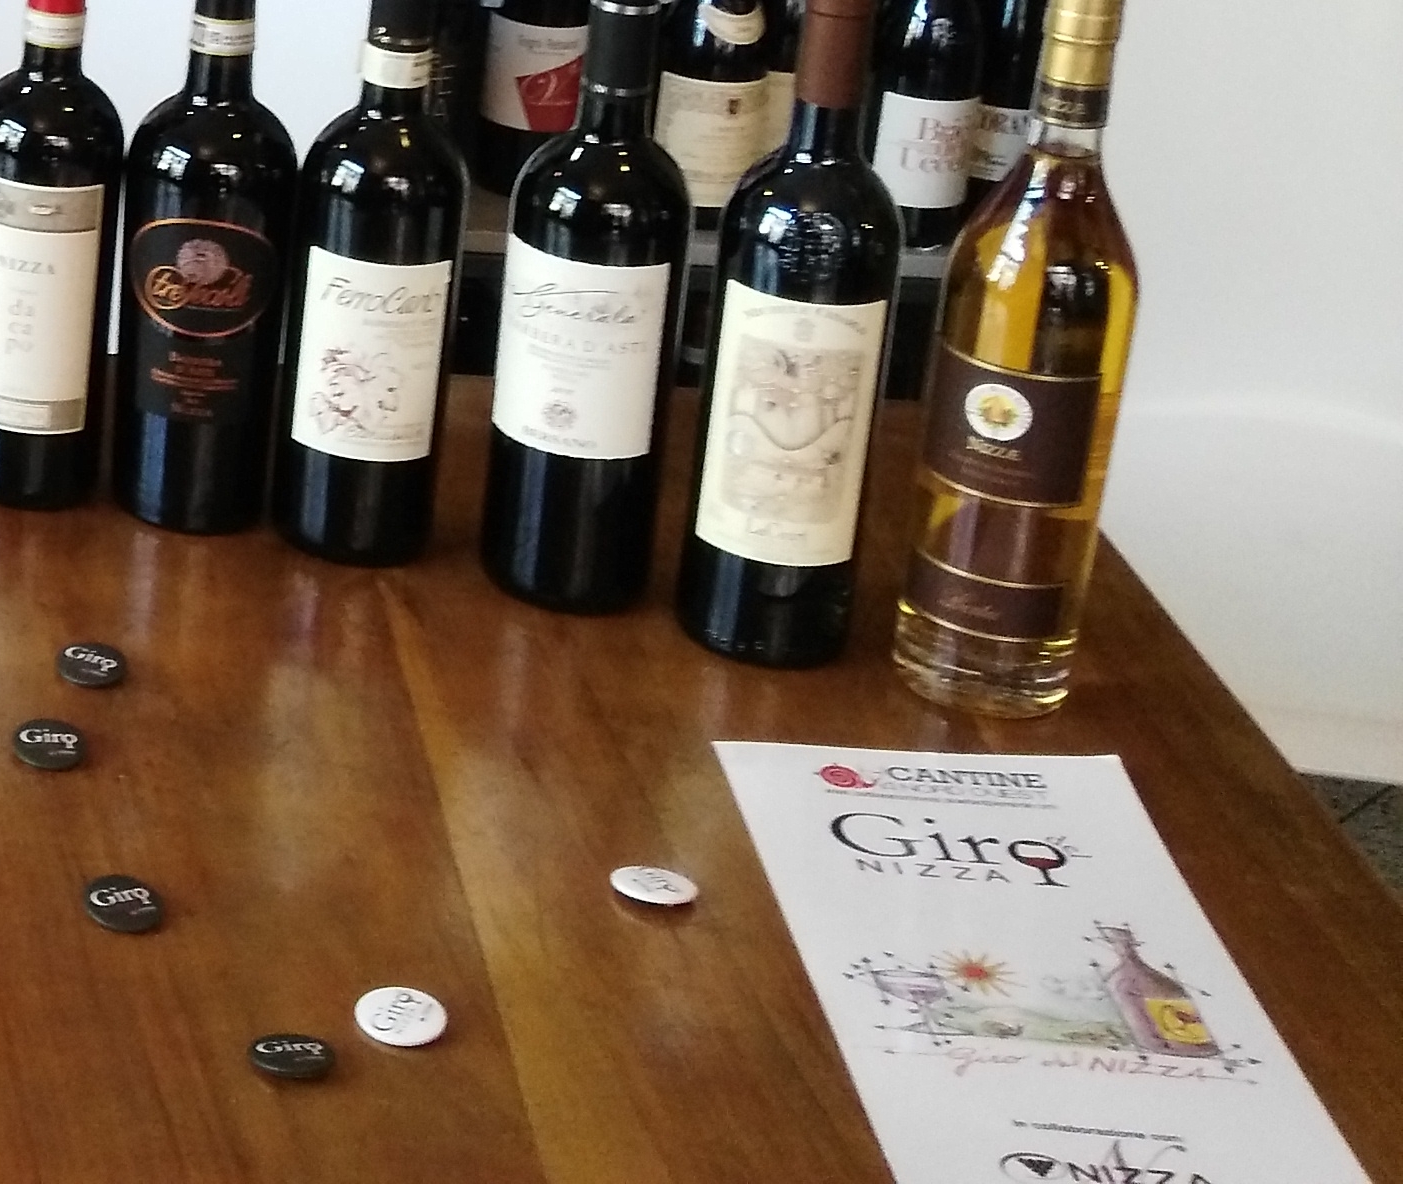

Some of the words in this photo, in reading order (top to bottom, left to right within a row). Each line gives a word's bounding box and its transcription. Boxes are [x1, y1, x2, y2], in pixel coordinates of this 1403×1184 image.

[64, 645, 119, 673] Giro
[18, 729, 79, 749] Giro
[887, 766, 1048, 790] CANTINE
[829, 812, 1068, 887] Giro
[855, 858, 1011, 883] NIZZA
[90, 886, 151, 907] Giro
[255, 1039, 324, 1056] Giro
